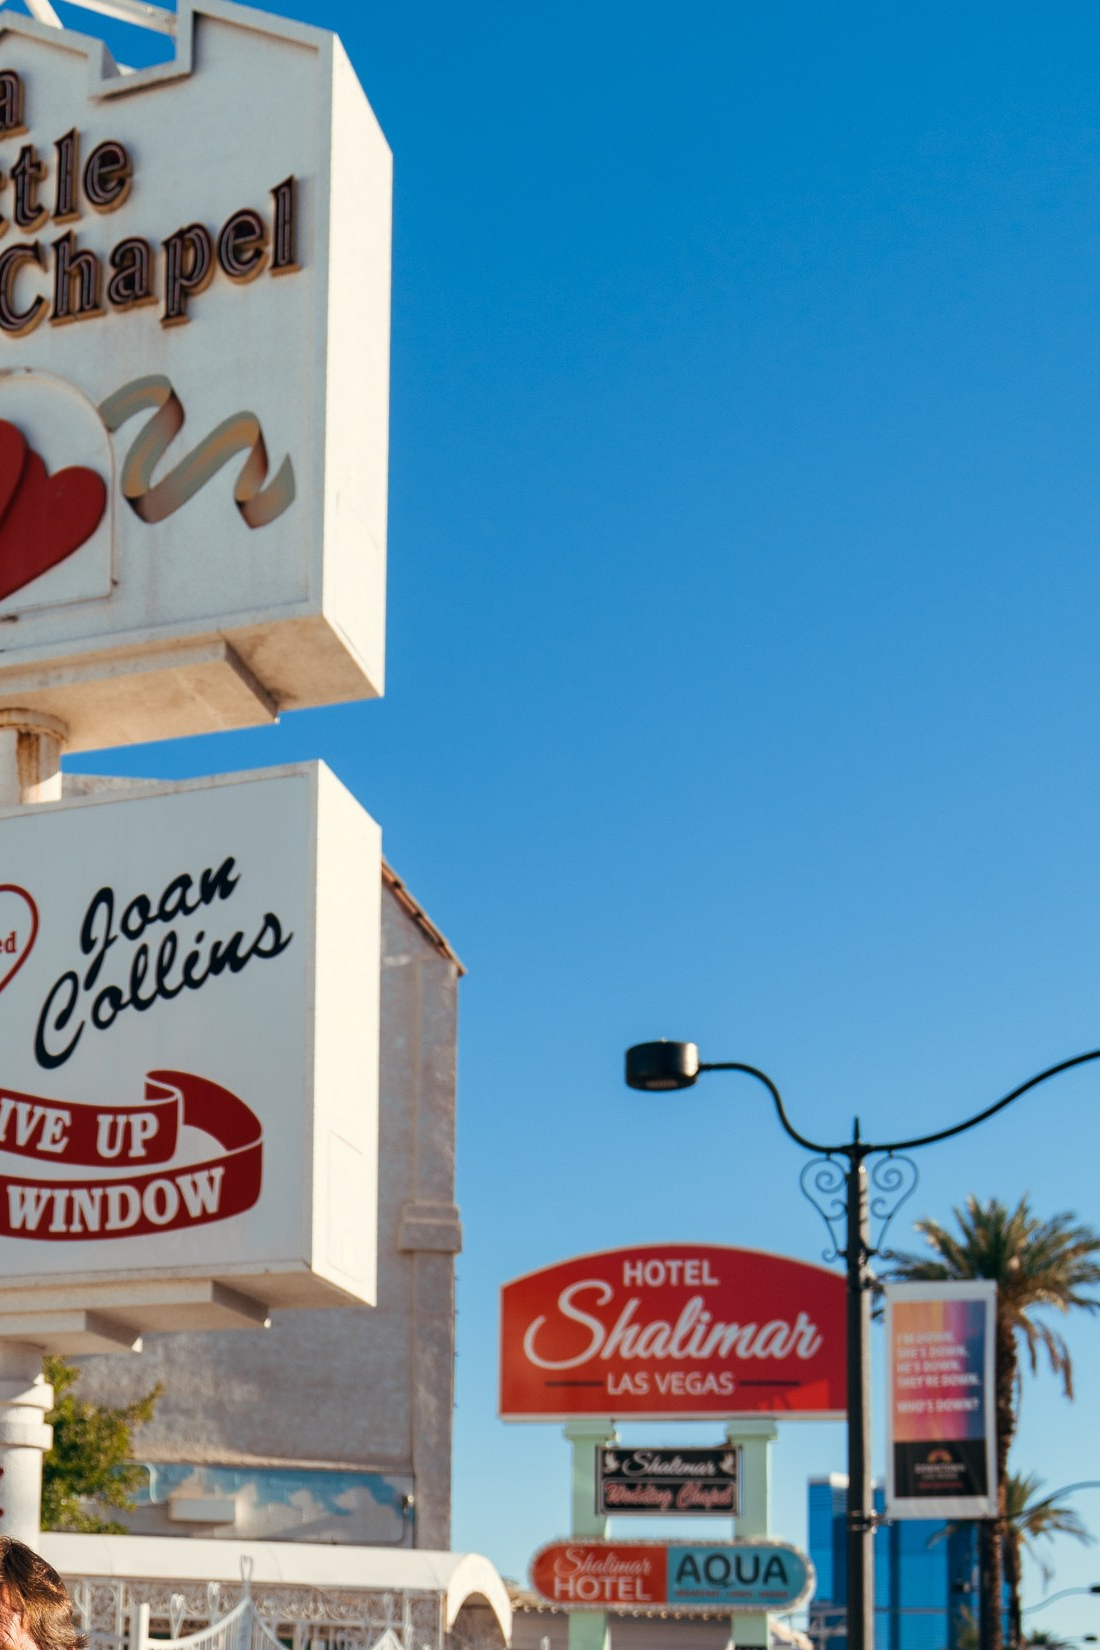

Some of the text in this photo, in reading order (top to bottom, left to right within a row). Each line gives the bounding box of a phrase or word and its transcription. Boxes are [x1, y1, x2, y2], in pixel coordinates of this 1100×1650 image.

[79, 856, 241, 992] Joan
[34, 912, 294, 1070] Collins
[95, 1111, 159, 1159] UP
[6, 1166, 225, 1234] WINDOW
[623, 1260, 719, 1287] HOTEL
[523, 1278, 824, 1370] Shalimar
[606, 1372, 734, 1395] LAS VEGAS
[621, 1449, 717, 1477] Shalimar
[554, 1546, 652, 1576] Shalimar
[675, 1553, 789, 1589] AQUA
[553, 1575, 652, 1600] HOTEL
